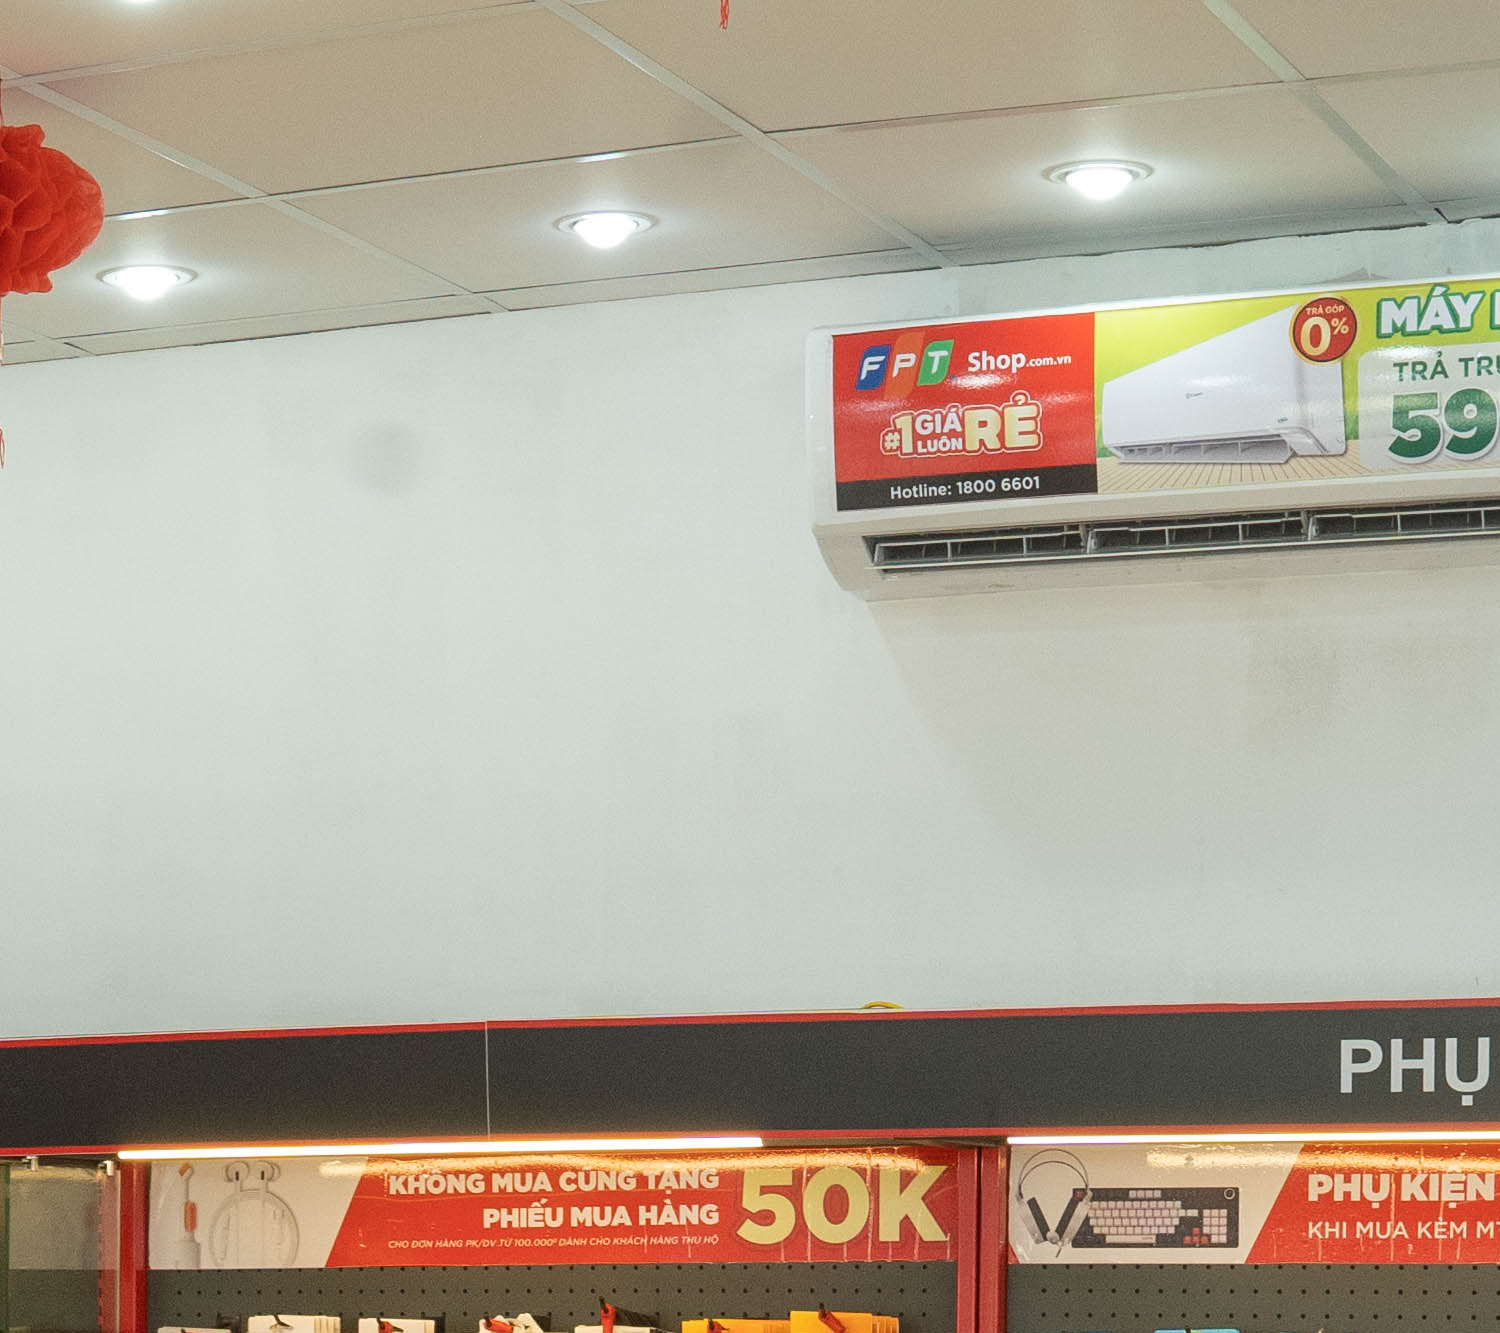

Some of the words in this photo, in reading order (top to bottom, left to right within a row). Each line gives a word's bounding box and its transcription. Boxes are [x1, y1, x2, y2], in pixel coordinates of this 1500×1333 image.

[1305, 304, 1325, 318] TRẢ
[1326, 303, 1345, 316] GÓP
[1378, 284, 1483, 338] MÁY
[1300, 316, 1349, 361] 0%
[858, 345, 953, 389] FPT
[966, 343, 1072, 375] Shop.com.vn
[1392, 346, 1452, 383] TRẢ
[881, 412, 917, 459] #1
[915, 405, 962, 438] GIÁ
[963, 388, 1042, 457] RẺ
[917, 430, 964, 459] LUÔN
[889, 481, 953, 500] Hotline:
[956, 478, 995, 496] 1800
[1000, 475, 1041, 493] 6601
[1338, 1037, 1492, 1106] PHỤ
[492, 1172, 553, 1193] MUA
[1308, 1173, 1391, 1208] PHỤ
[1401, 1167, 1495, 1208] KIỆN
[483, 1198, 563, 1228] PHIẾU
[570, 1206, 631, 1227] MUA
[639, 1199, 719, 1226] HÀNG
[736, 1164, 949, 1247] 50K
[388, 1240, 409, 1249] CHO
[435, 1238, 463, 1248] HÀNG
[559, 1236, 587, 1247] DÀNH
[589, 1238, 610, 1247] CHO
[612, 1236, 647, 1246] KHÁCH
[649, 1235, 678, 1245] HÀNG
[681, 1236, 702, 1245] THU
[1308, 1222, 1348, 1239] KHI
[1356, 1222, 1408, 1239] MUA
[1417, 1217, 1469, 1239] KÈM
